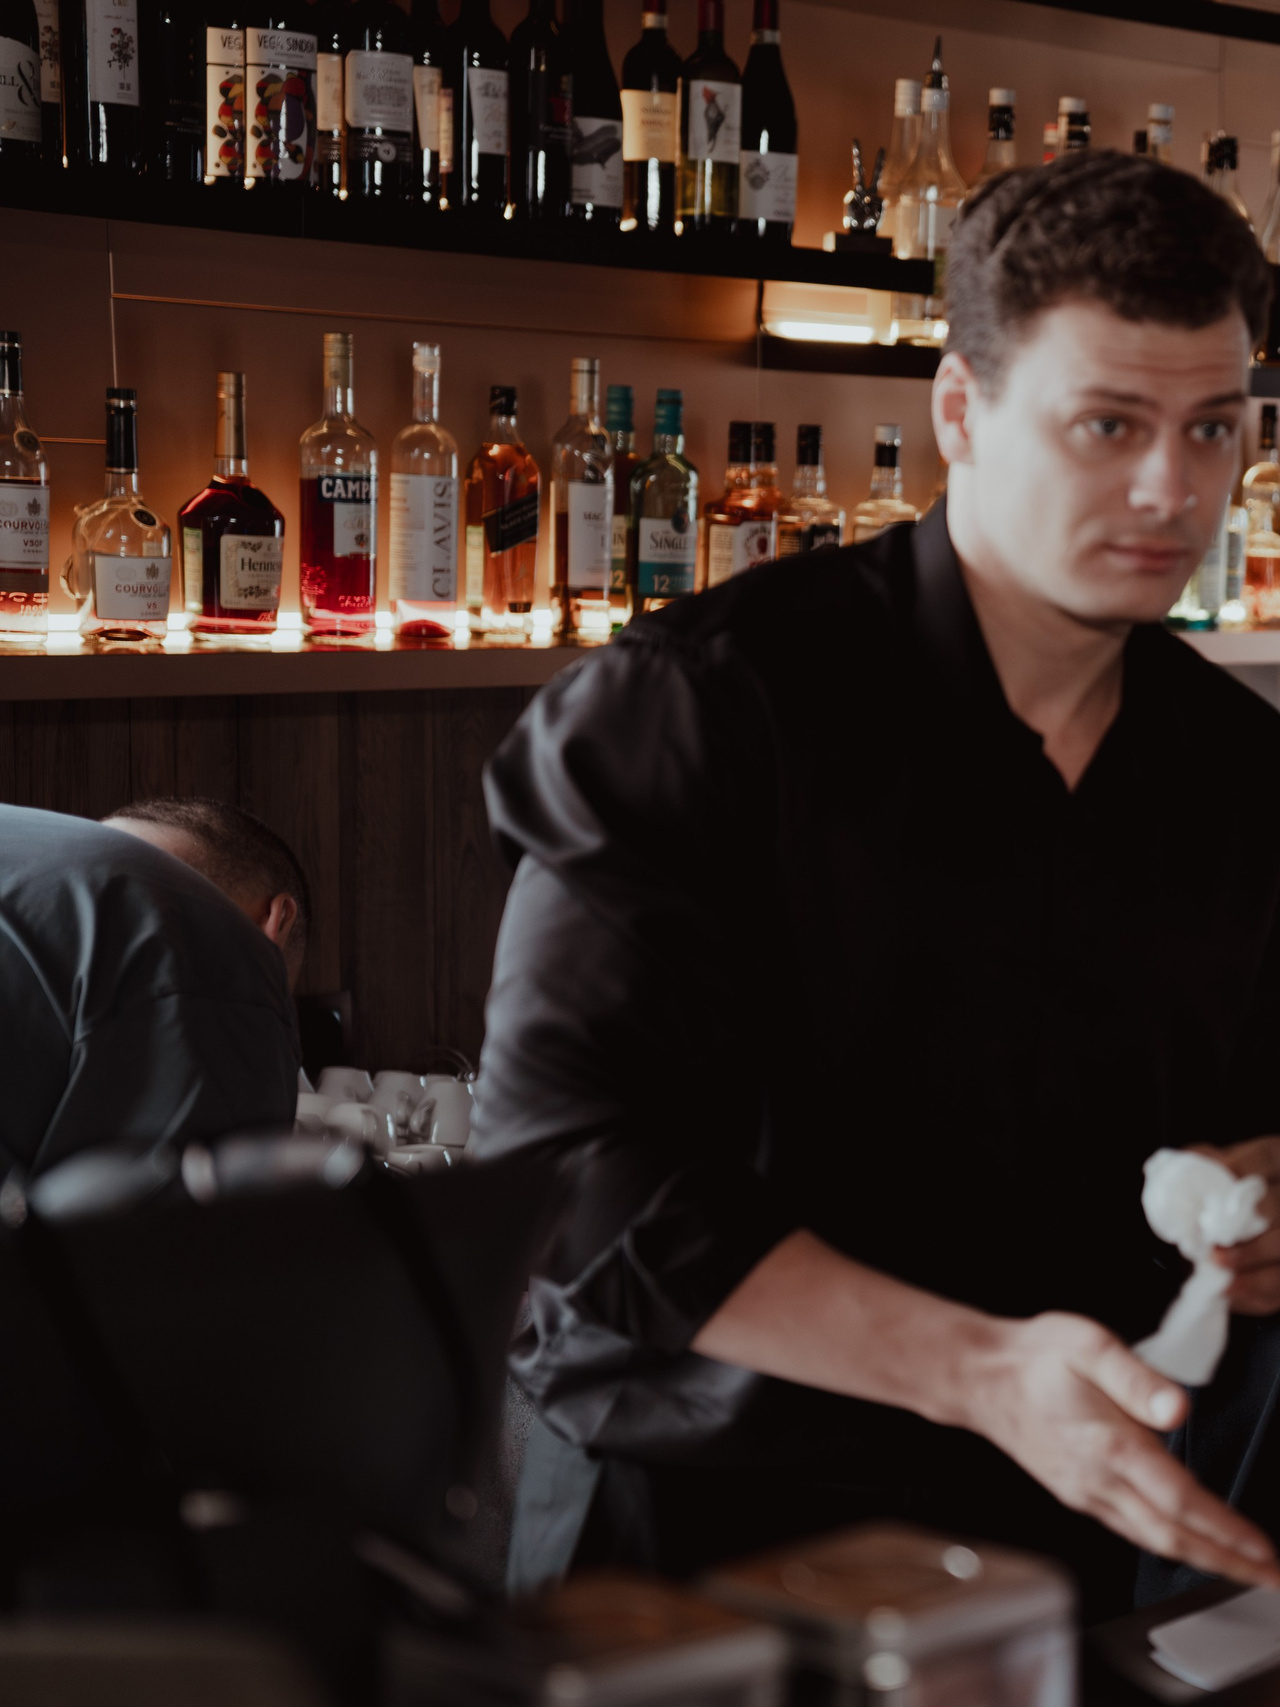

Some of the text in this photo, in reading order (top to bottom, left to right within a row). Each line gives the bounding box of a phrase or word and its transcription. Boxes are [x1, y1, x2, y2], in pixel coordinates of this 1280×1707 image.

[220, 33, 243, 50] VEG
[257, 33, 283, 50] VEGA
[652, 574, 670, 592] 12
